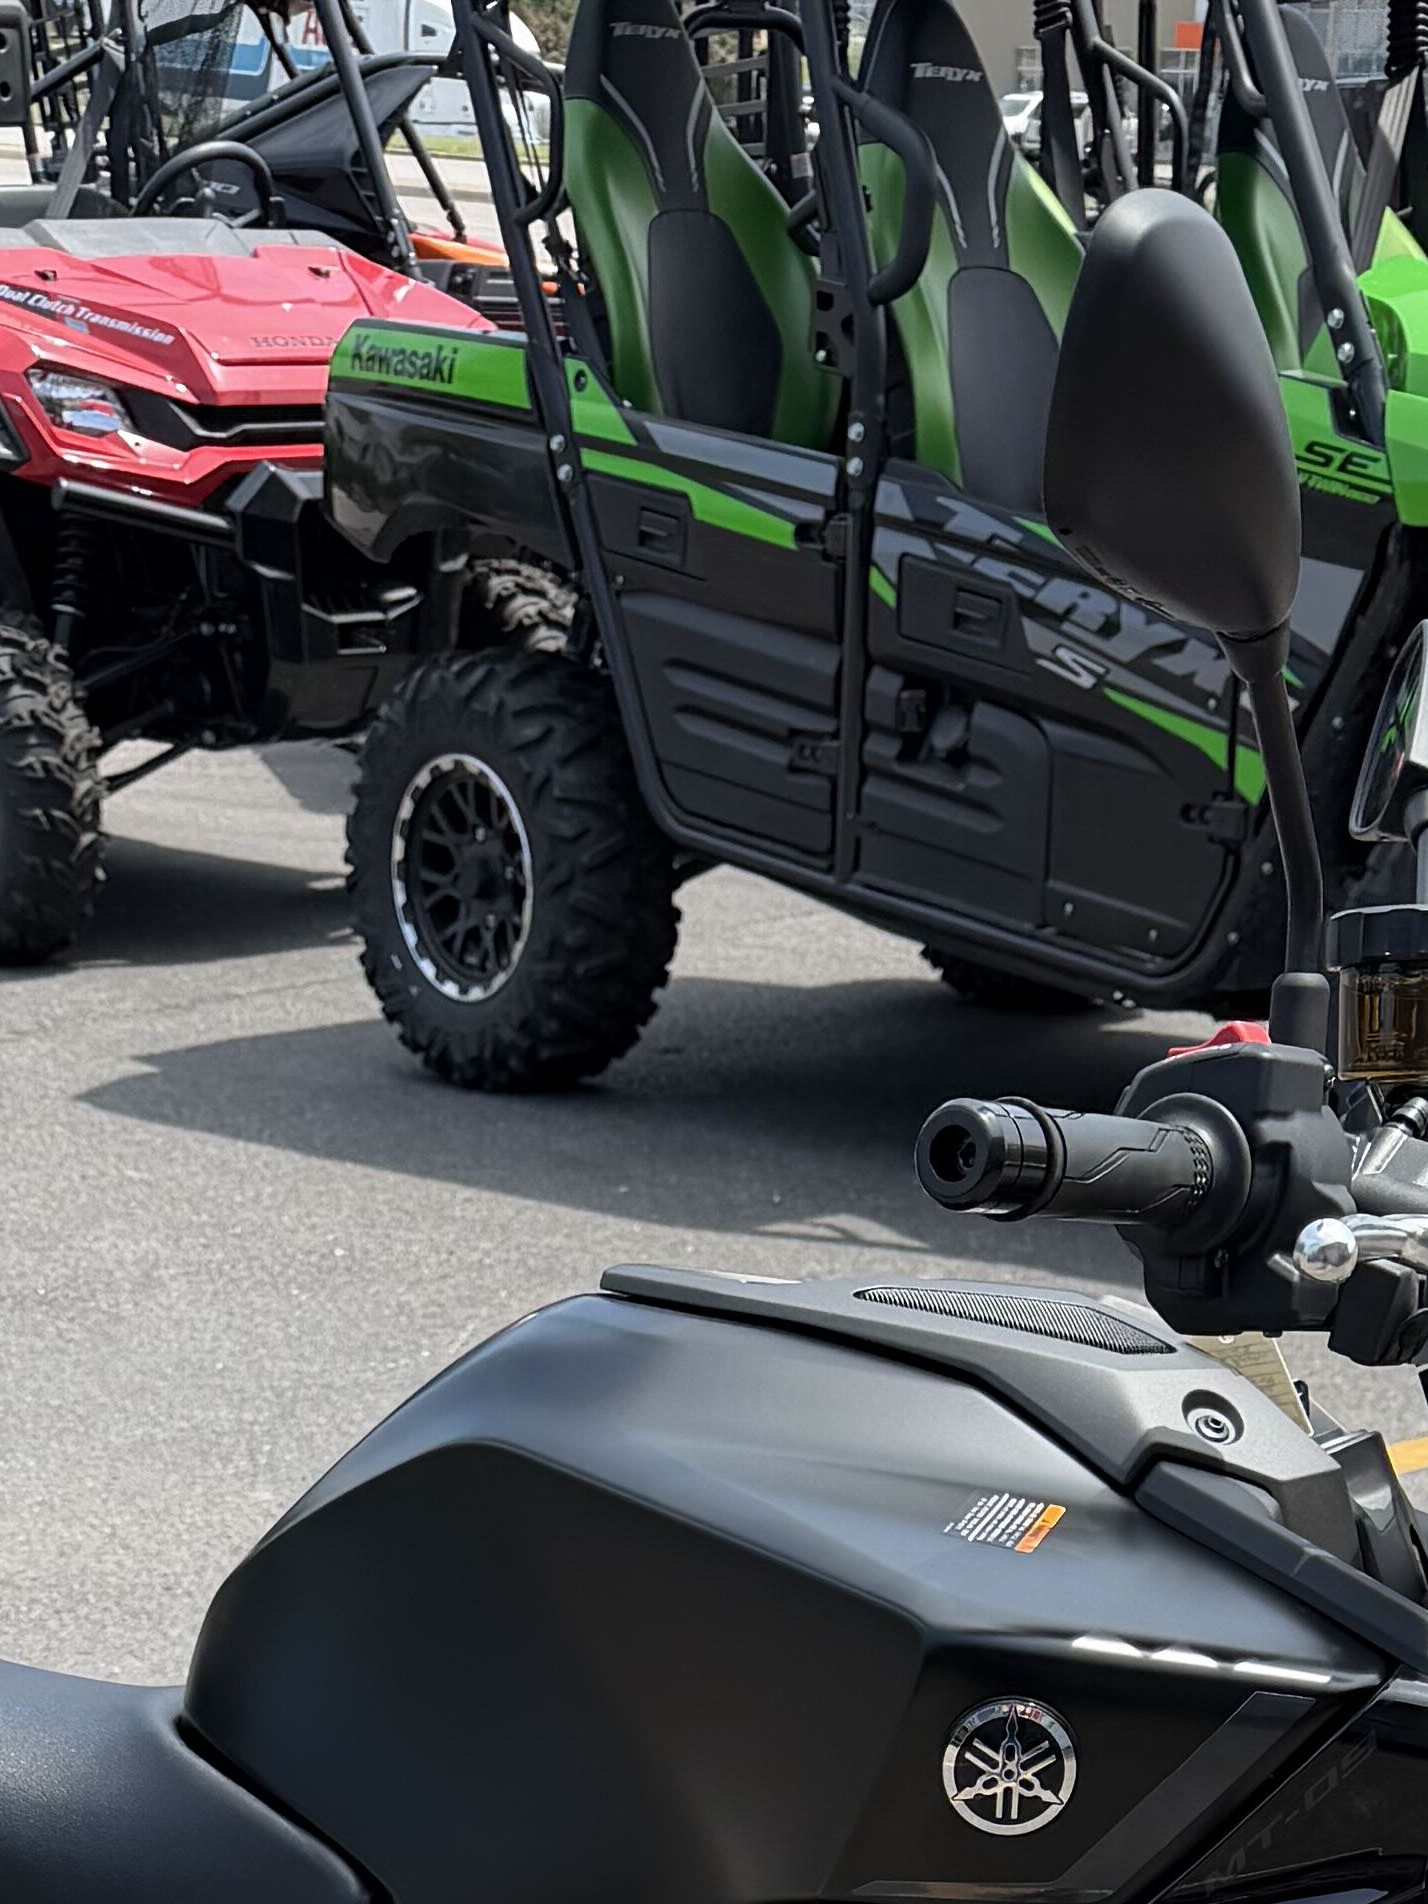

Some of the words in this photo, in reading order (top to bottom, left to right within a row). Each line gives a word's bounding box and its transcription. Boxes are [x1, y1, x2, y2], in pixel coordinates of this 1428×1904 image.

[28, 293, 76, 316] Clutch
[76, 306, 176, 346] Transmission
[351, 334, 459, 385] Kawasaki
[1295, 440, 1392, 486] SE
